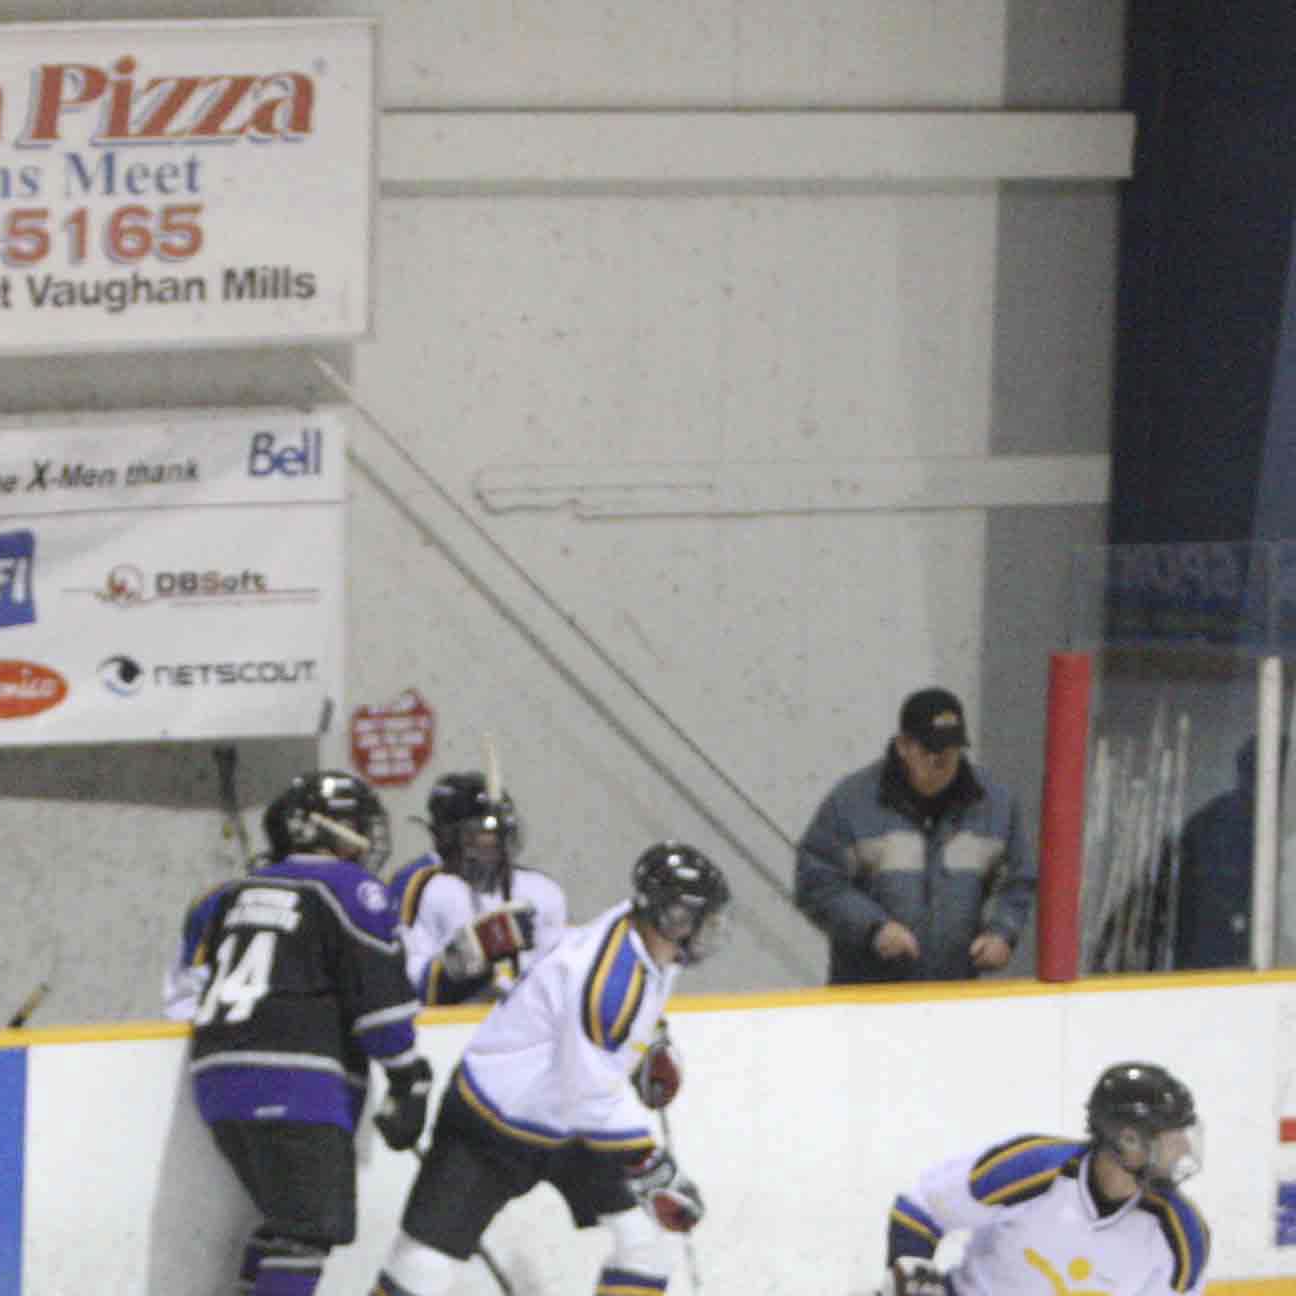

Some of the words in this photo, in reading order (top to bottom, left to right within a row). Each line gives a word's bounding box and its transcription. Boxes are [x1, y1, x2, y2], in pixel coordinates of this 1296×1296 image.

[15, 53, 318, 150] Pizza
[64, 150, 201, 198] Meet
[26, 270, 208, 316] Vaughan
[222, 265, 317, 304] Mills
[25, 460, 116, 494] X-Men
[125, 458, 199, 485] thank
[248, 431, 322, 477] Bell
[155, 569, 268, 594] DBSoft
[153, 659, 317, 687] NETSCOUT
[193, 931, 277, 1026] 14
